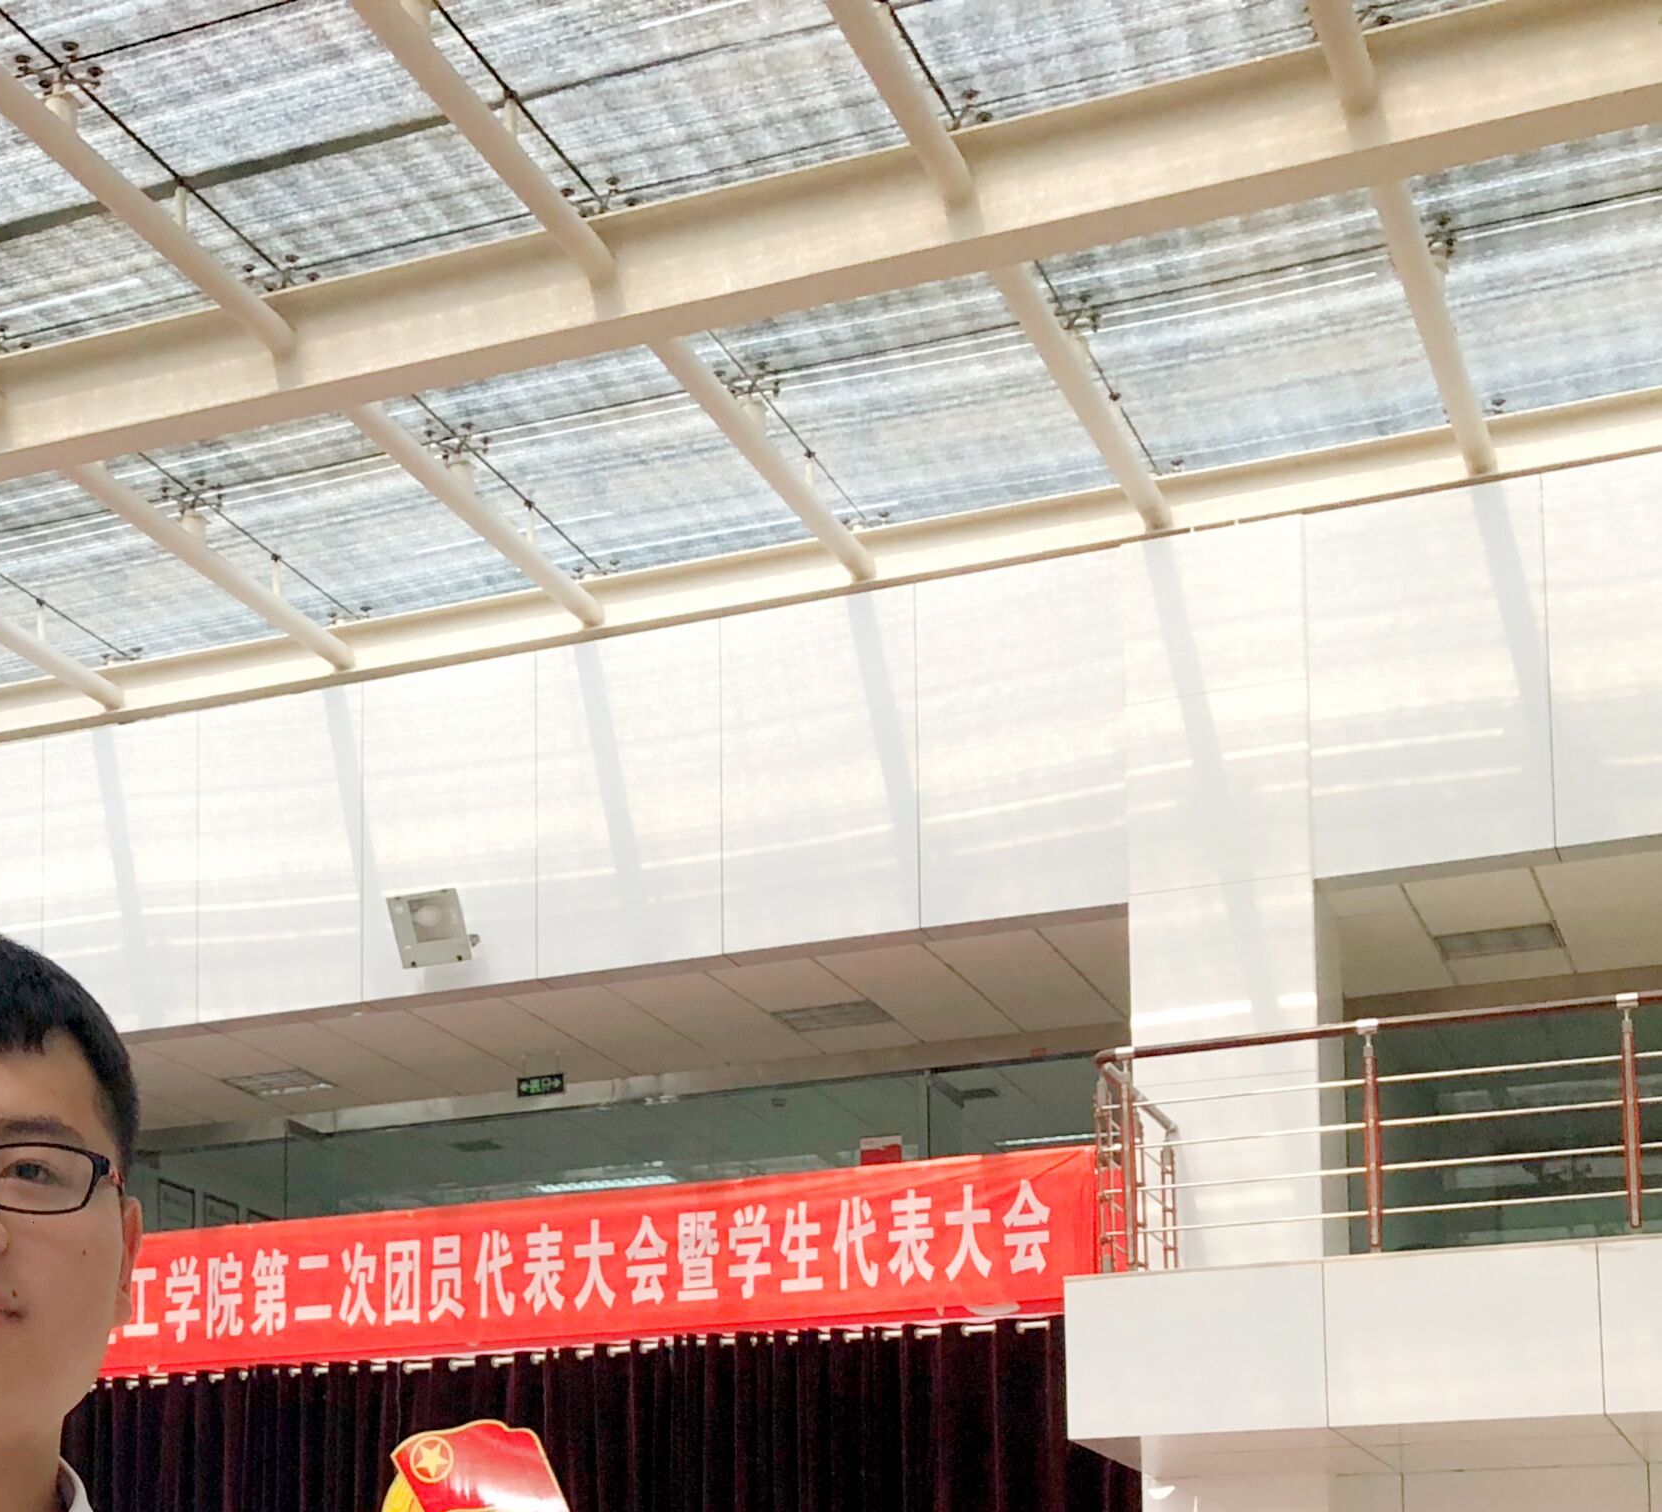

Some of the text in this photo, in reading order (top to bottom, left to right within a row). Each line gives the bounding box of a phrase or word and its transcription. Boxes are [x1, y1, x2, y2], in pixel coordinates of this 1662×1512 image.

[107, 1179, 1051, 1345] 工学院第二次团员代表大会暨学生代表大会
